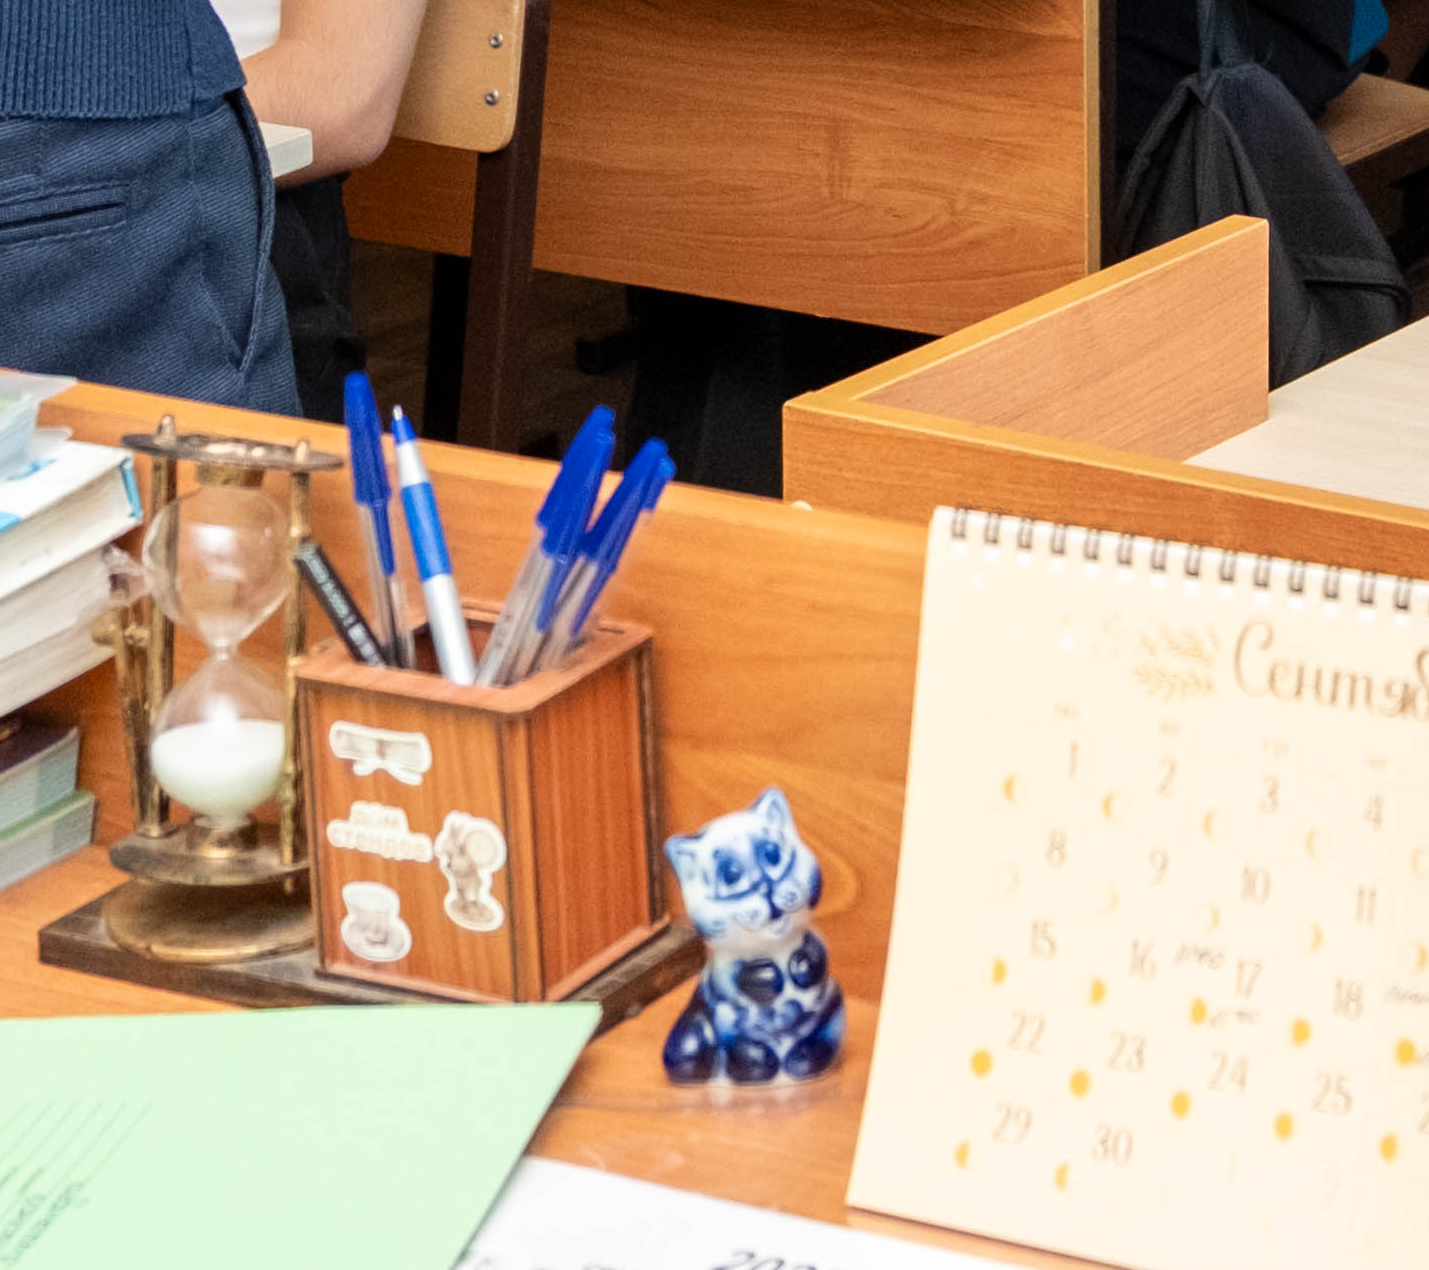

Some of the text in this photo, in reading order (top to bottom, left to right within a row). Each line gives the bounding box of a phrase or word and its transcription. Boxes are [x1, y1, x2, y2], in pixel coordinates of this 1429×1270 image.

[1259, 776, 1281, 816] 3
[1044, 830, 1068, 869] 8
[1240, 864, 1273, 906] 10
[1353, 885, 1379, 926] 11
[1029, 919, 1058, 961] 15
[1128, 939, 1159, 982] 16
[1234, 958, 1265, 1001] 17
[1333, 978, 1365, 1021] 18
[1005, 1010, 1048, 1056] 22
[1107, 1030, 1148, 1074] 23
[1207, 1051, 1251, 1095] 24
[1311, 1071, 1354, 1117] 25
[991, 1101, 1135, 1167] 29 30
